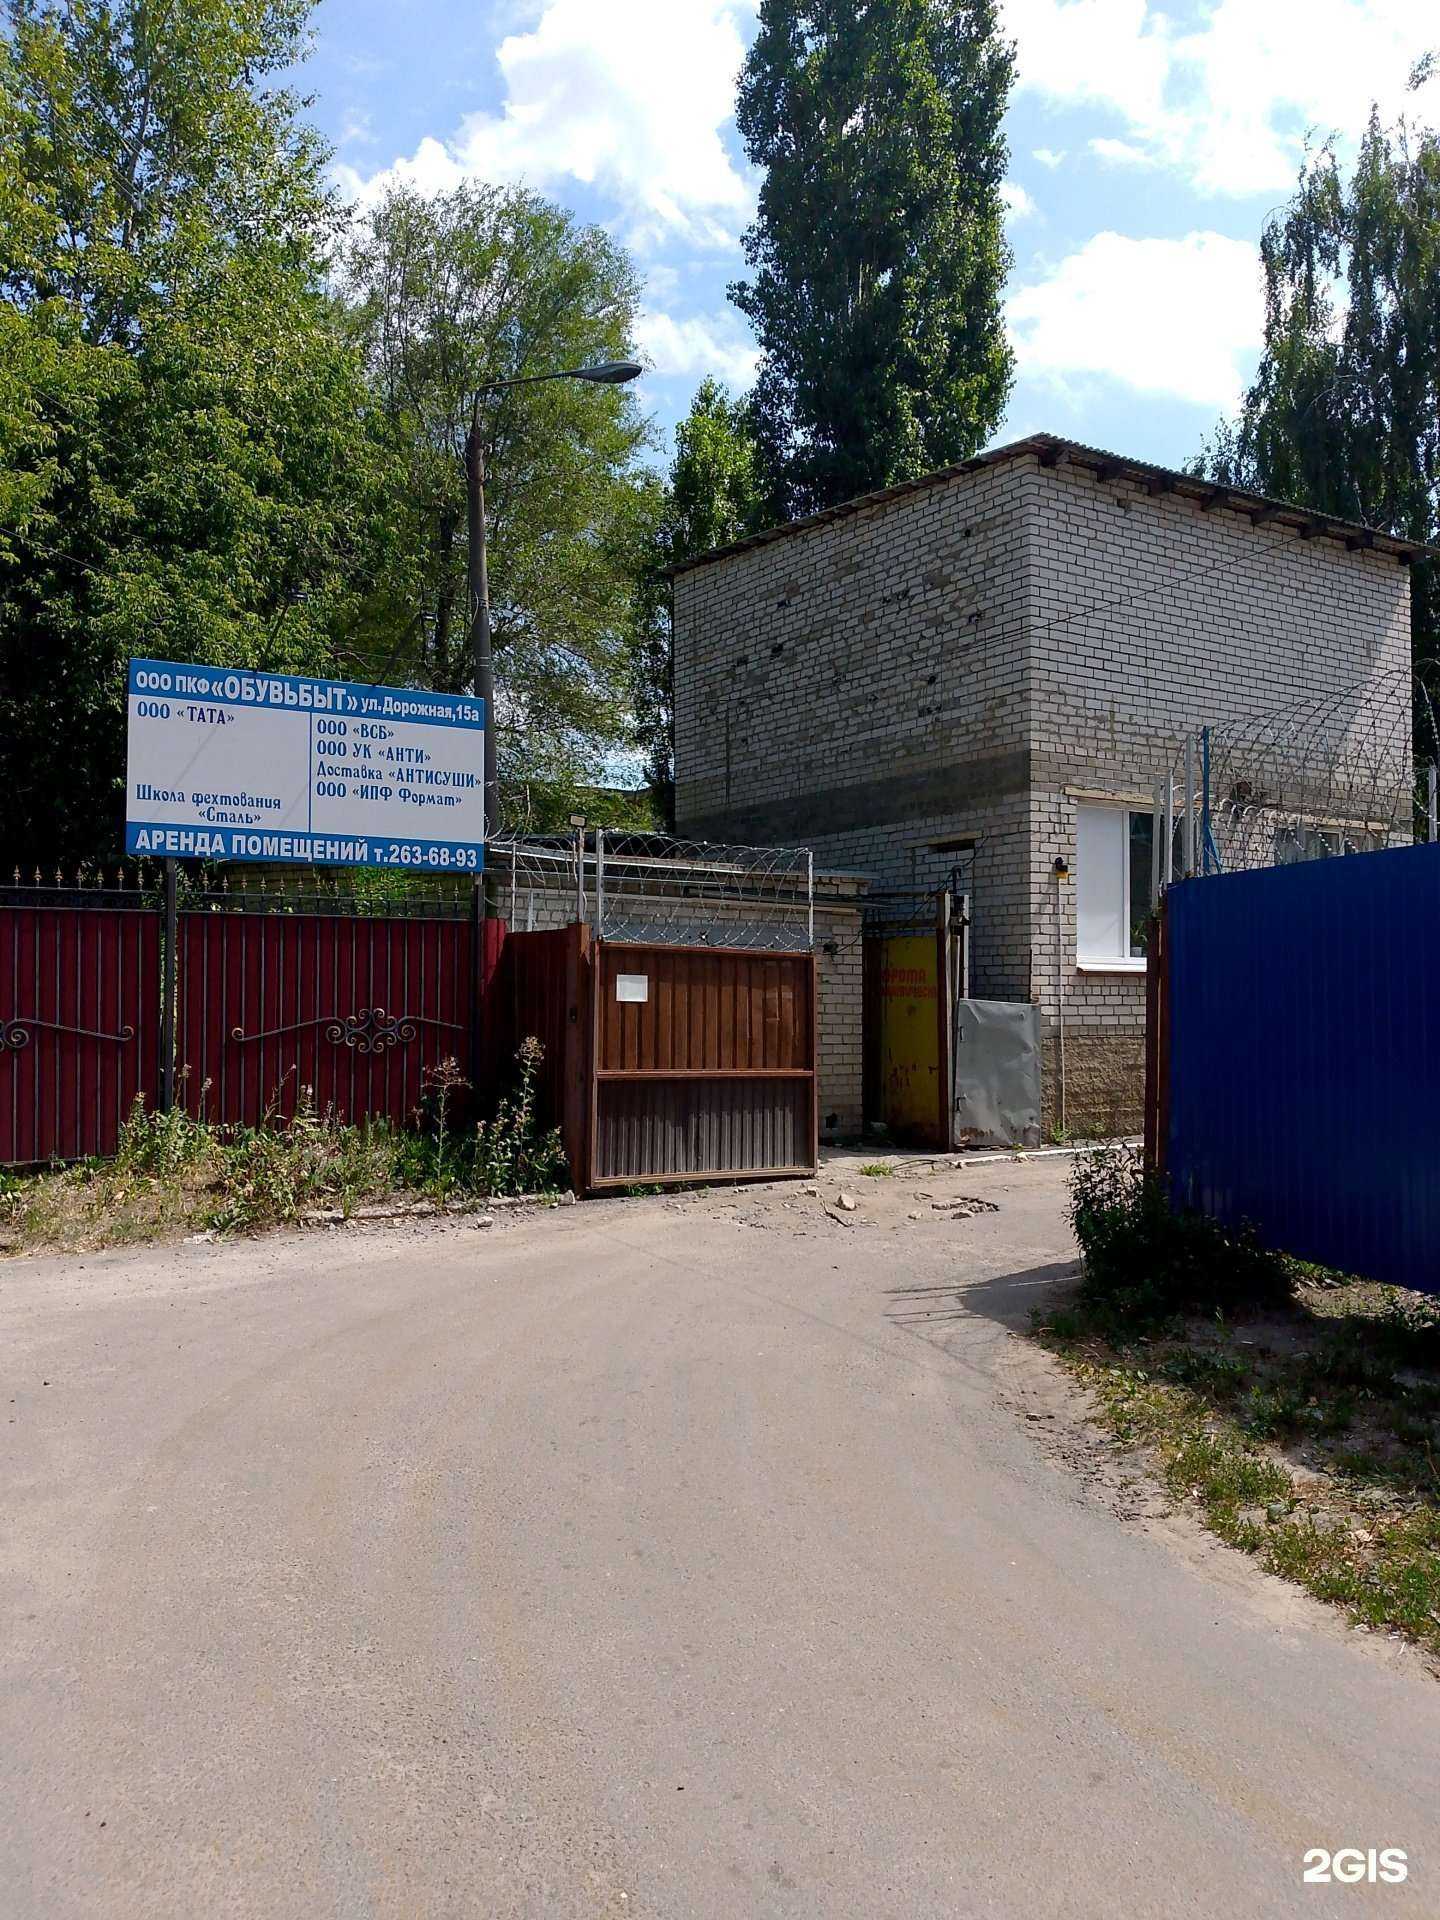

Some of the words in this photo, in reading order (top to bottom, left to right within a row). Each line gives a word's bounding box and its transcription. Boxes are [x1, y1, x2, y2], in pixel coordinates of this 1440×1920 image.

[136, 671, 172, 690] ООО
[175, 675, 210, 694] ПКФ
[211, 675, 358, 712] «ОБУВЬБЫТ»
[137, 701, 170, 719] ООО
[317, 719, 347, 736] ООО
[352, 723, 394, 740] «ВСБ»
[317, 740, 347, 756] ООО
[352, 743, 371, 759] УК
[379, 746, 431, 764] «АНТИ»
[317, 761, 383, 780] Доставка
[388, 767, 481, 788] «АНТИСУШИ»
[136, 784, 185, 803] Школа
[191, 791, 281, 809] фехтования
[316, 781, 347, 797] ООО
[352, 785, 392, 801] «ИПФ
[398, 788, 462, 807] Формат»
[198, 806, 261, 824] «Сталь»
[135, 829, 225, 856] АРЕНДА
[232, 834, 368, 863] ПОМЕЩЕНИЙ
